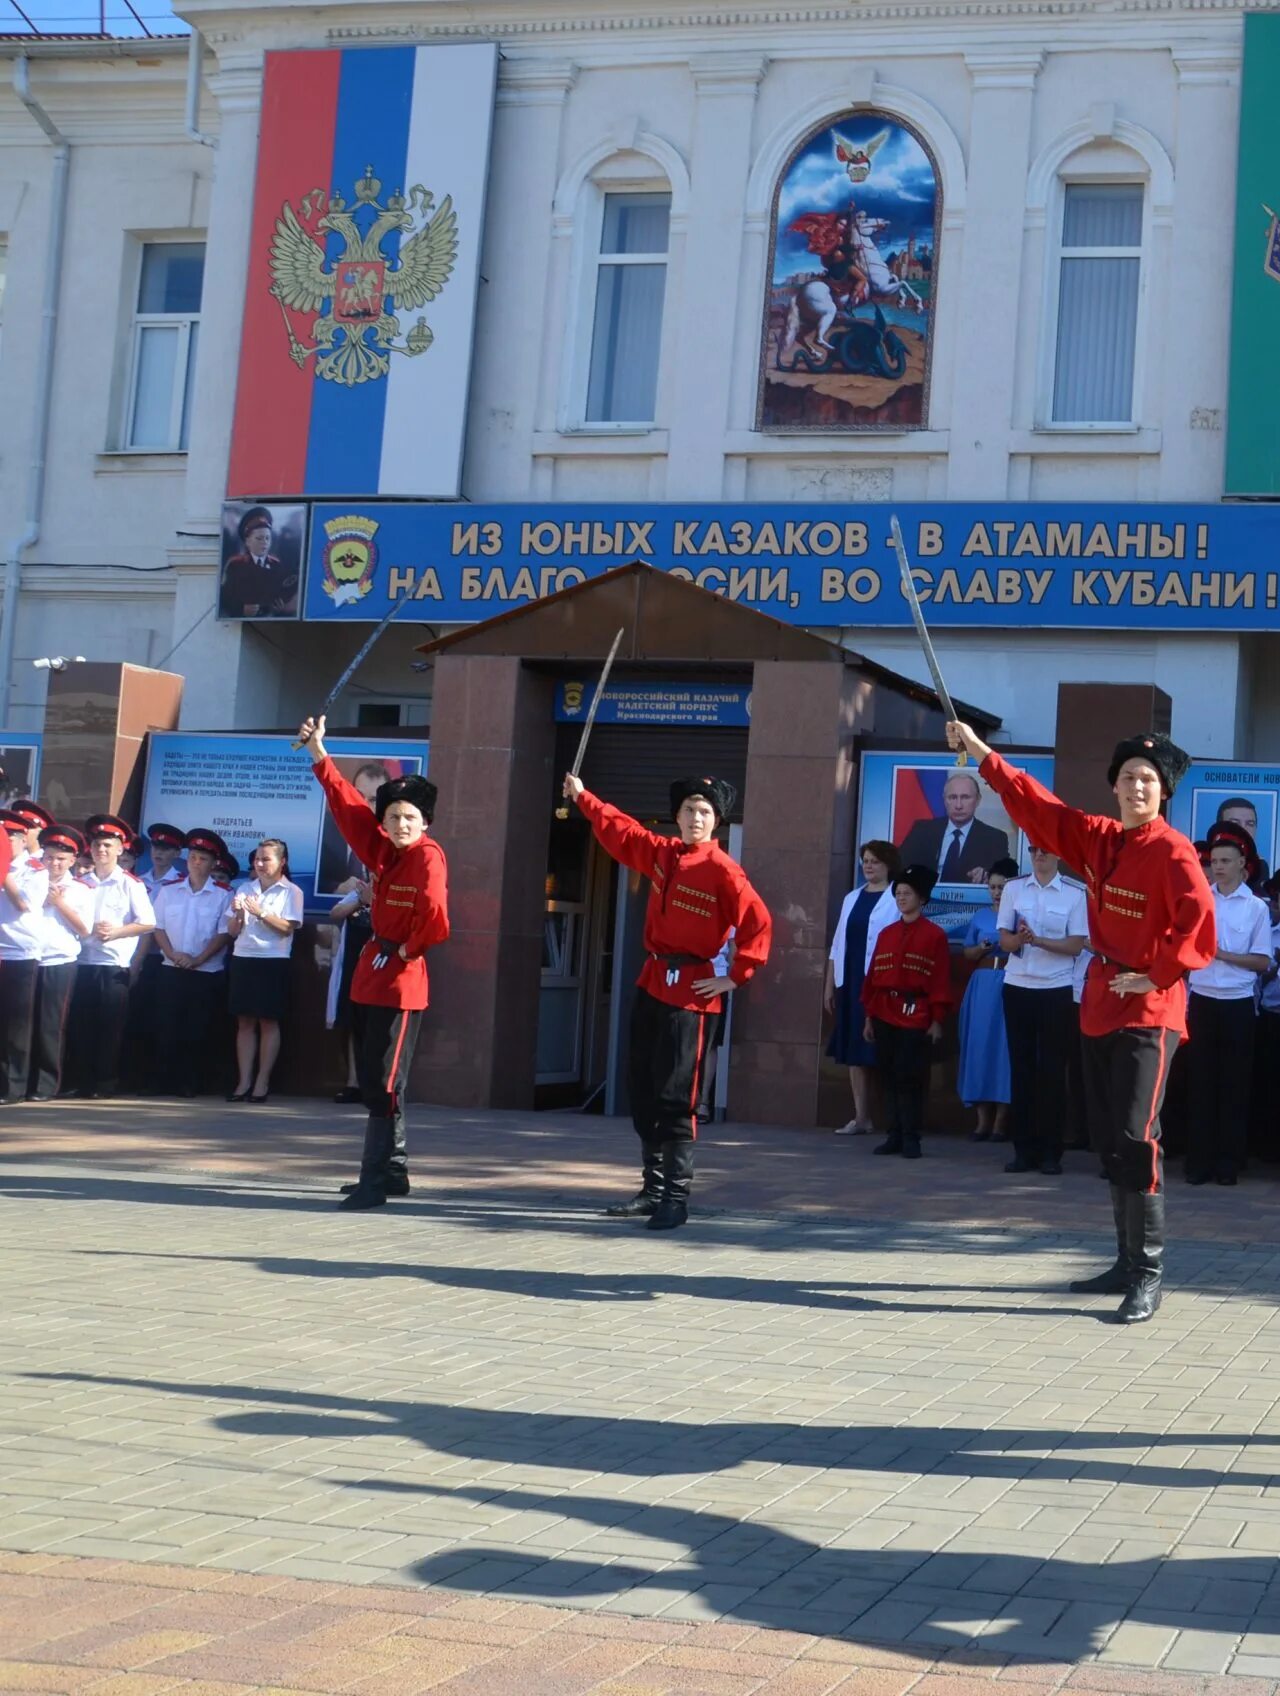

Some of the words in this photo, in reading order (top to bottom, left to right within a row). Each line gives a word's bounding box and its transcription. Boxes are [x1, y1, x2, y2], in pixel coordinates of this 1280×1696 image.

[451, 522, 503, 556] ИЗ
[520, 521, 654, 555] ЮНЫХ
[673, 521, 869, 556] КАЗАКОВ
[918, 521, 943, 557] В
[388, 566, 444, 601] НА
[819, 568, 881, 603] ВО
[900, 568, 1053, 605] СЛАВУ
[694, 693, 739, 703] КАЗАЧИЙ
[618, 701, 676, 711] КАДЕТСКИЙ
[680, 702, 718, 711] КОРПУС
[617, 711, 693, 722] Краснодарского
[1204, 771, 1260, 785] ОСНОВАТЕЛИ
